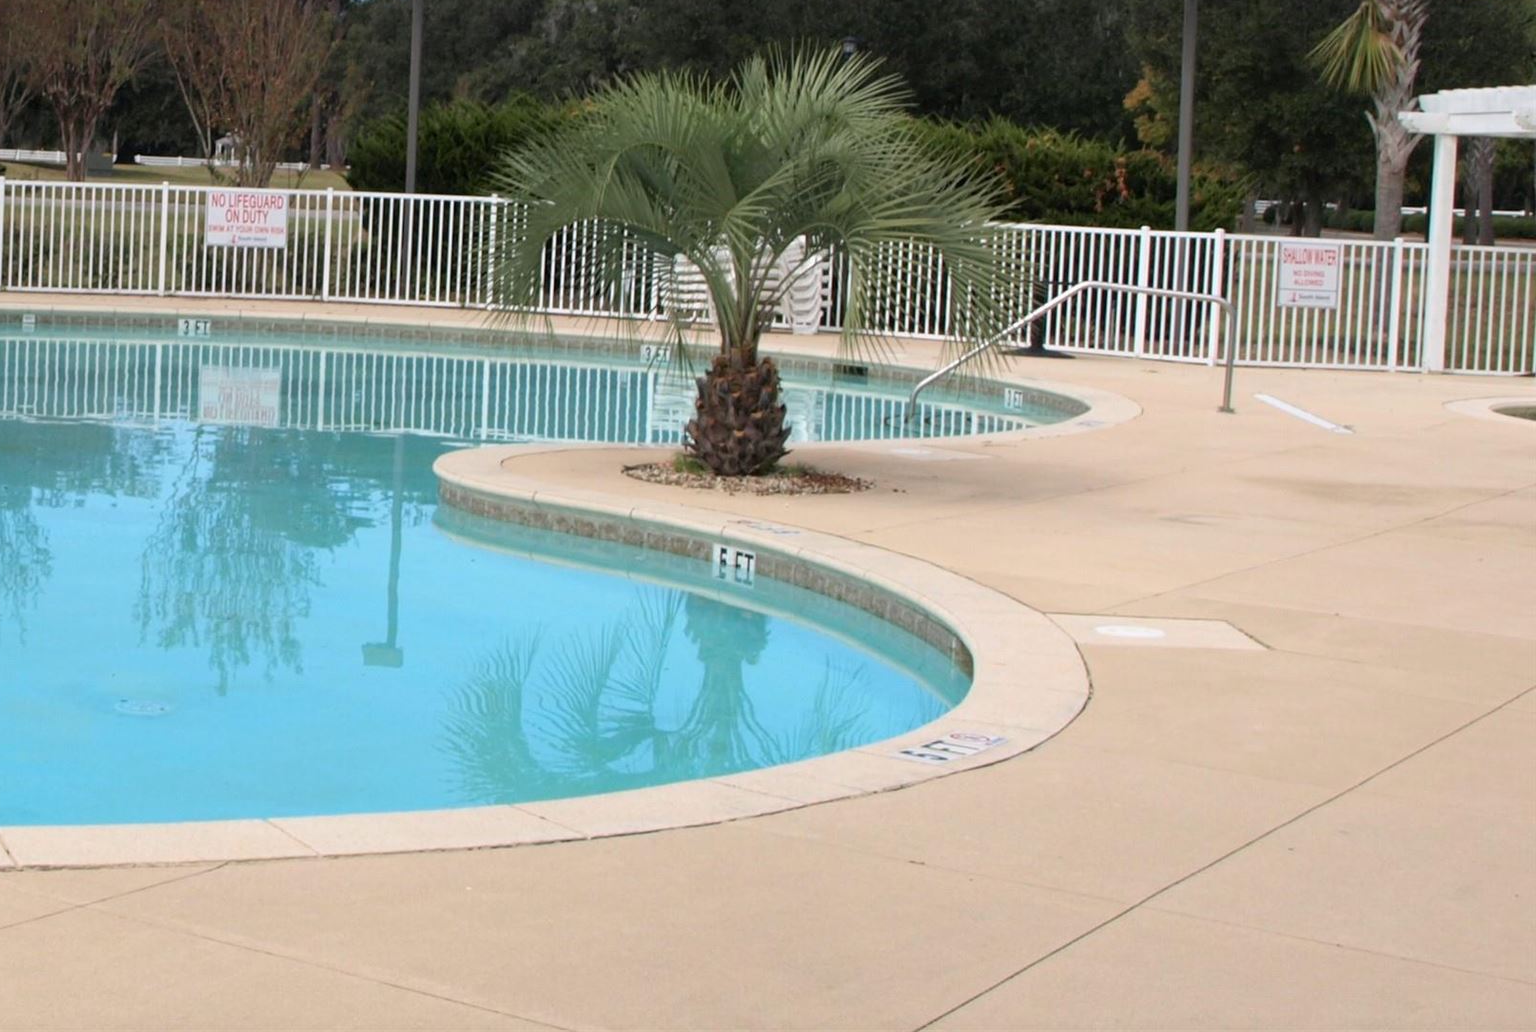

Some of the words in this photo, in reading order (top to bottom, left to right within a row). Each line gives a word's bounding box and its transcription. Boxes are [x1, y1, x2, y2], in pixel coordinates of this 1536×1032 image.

[211, 193, 226, 208] NO
[229, 194, 284, 209] LIFEGUARD
[225, 209, 239, 223] ON
[242, 210, 269, 224] DUTY
[195, 320, 208, 335] FT
